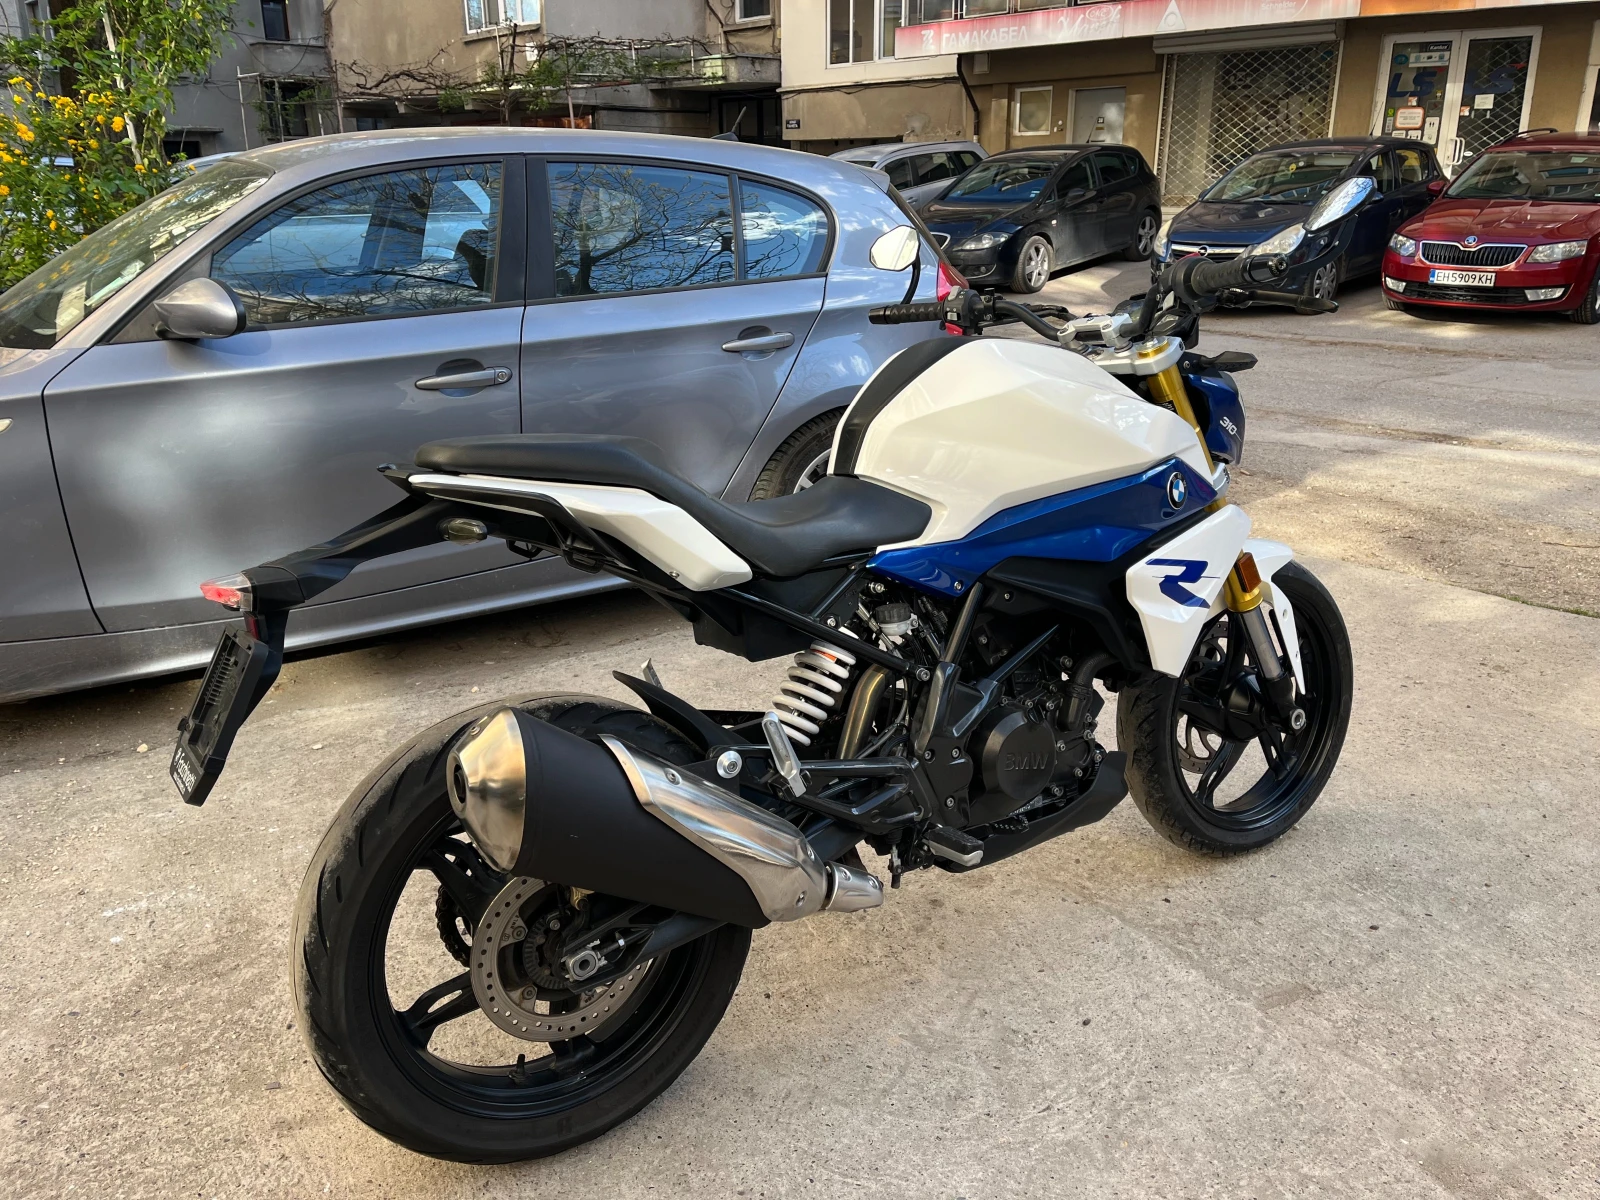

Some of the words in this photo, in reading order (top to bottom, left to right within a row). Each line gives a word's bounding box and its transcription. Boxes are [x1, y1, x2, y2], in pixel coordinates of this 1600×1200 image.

[942, 25, 1029, 49] ГАМАКАБЕЛ
[1220, 416, 1238, 435] 310
[1145, 558, 1211, 609] R
[1004, 752, 1049, 771] BMW
